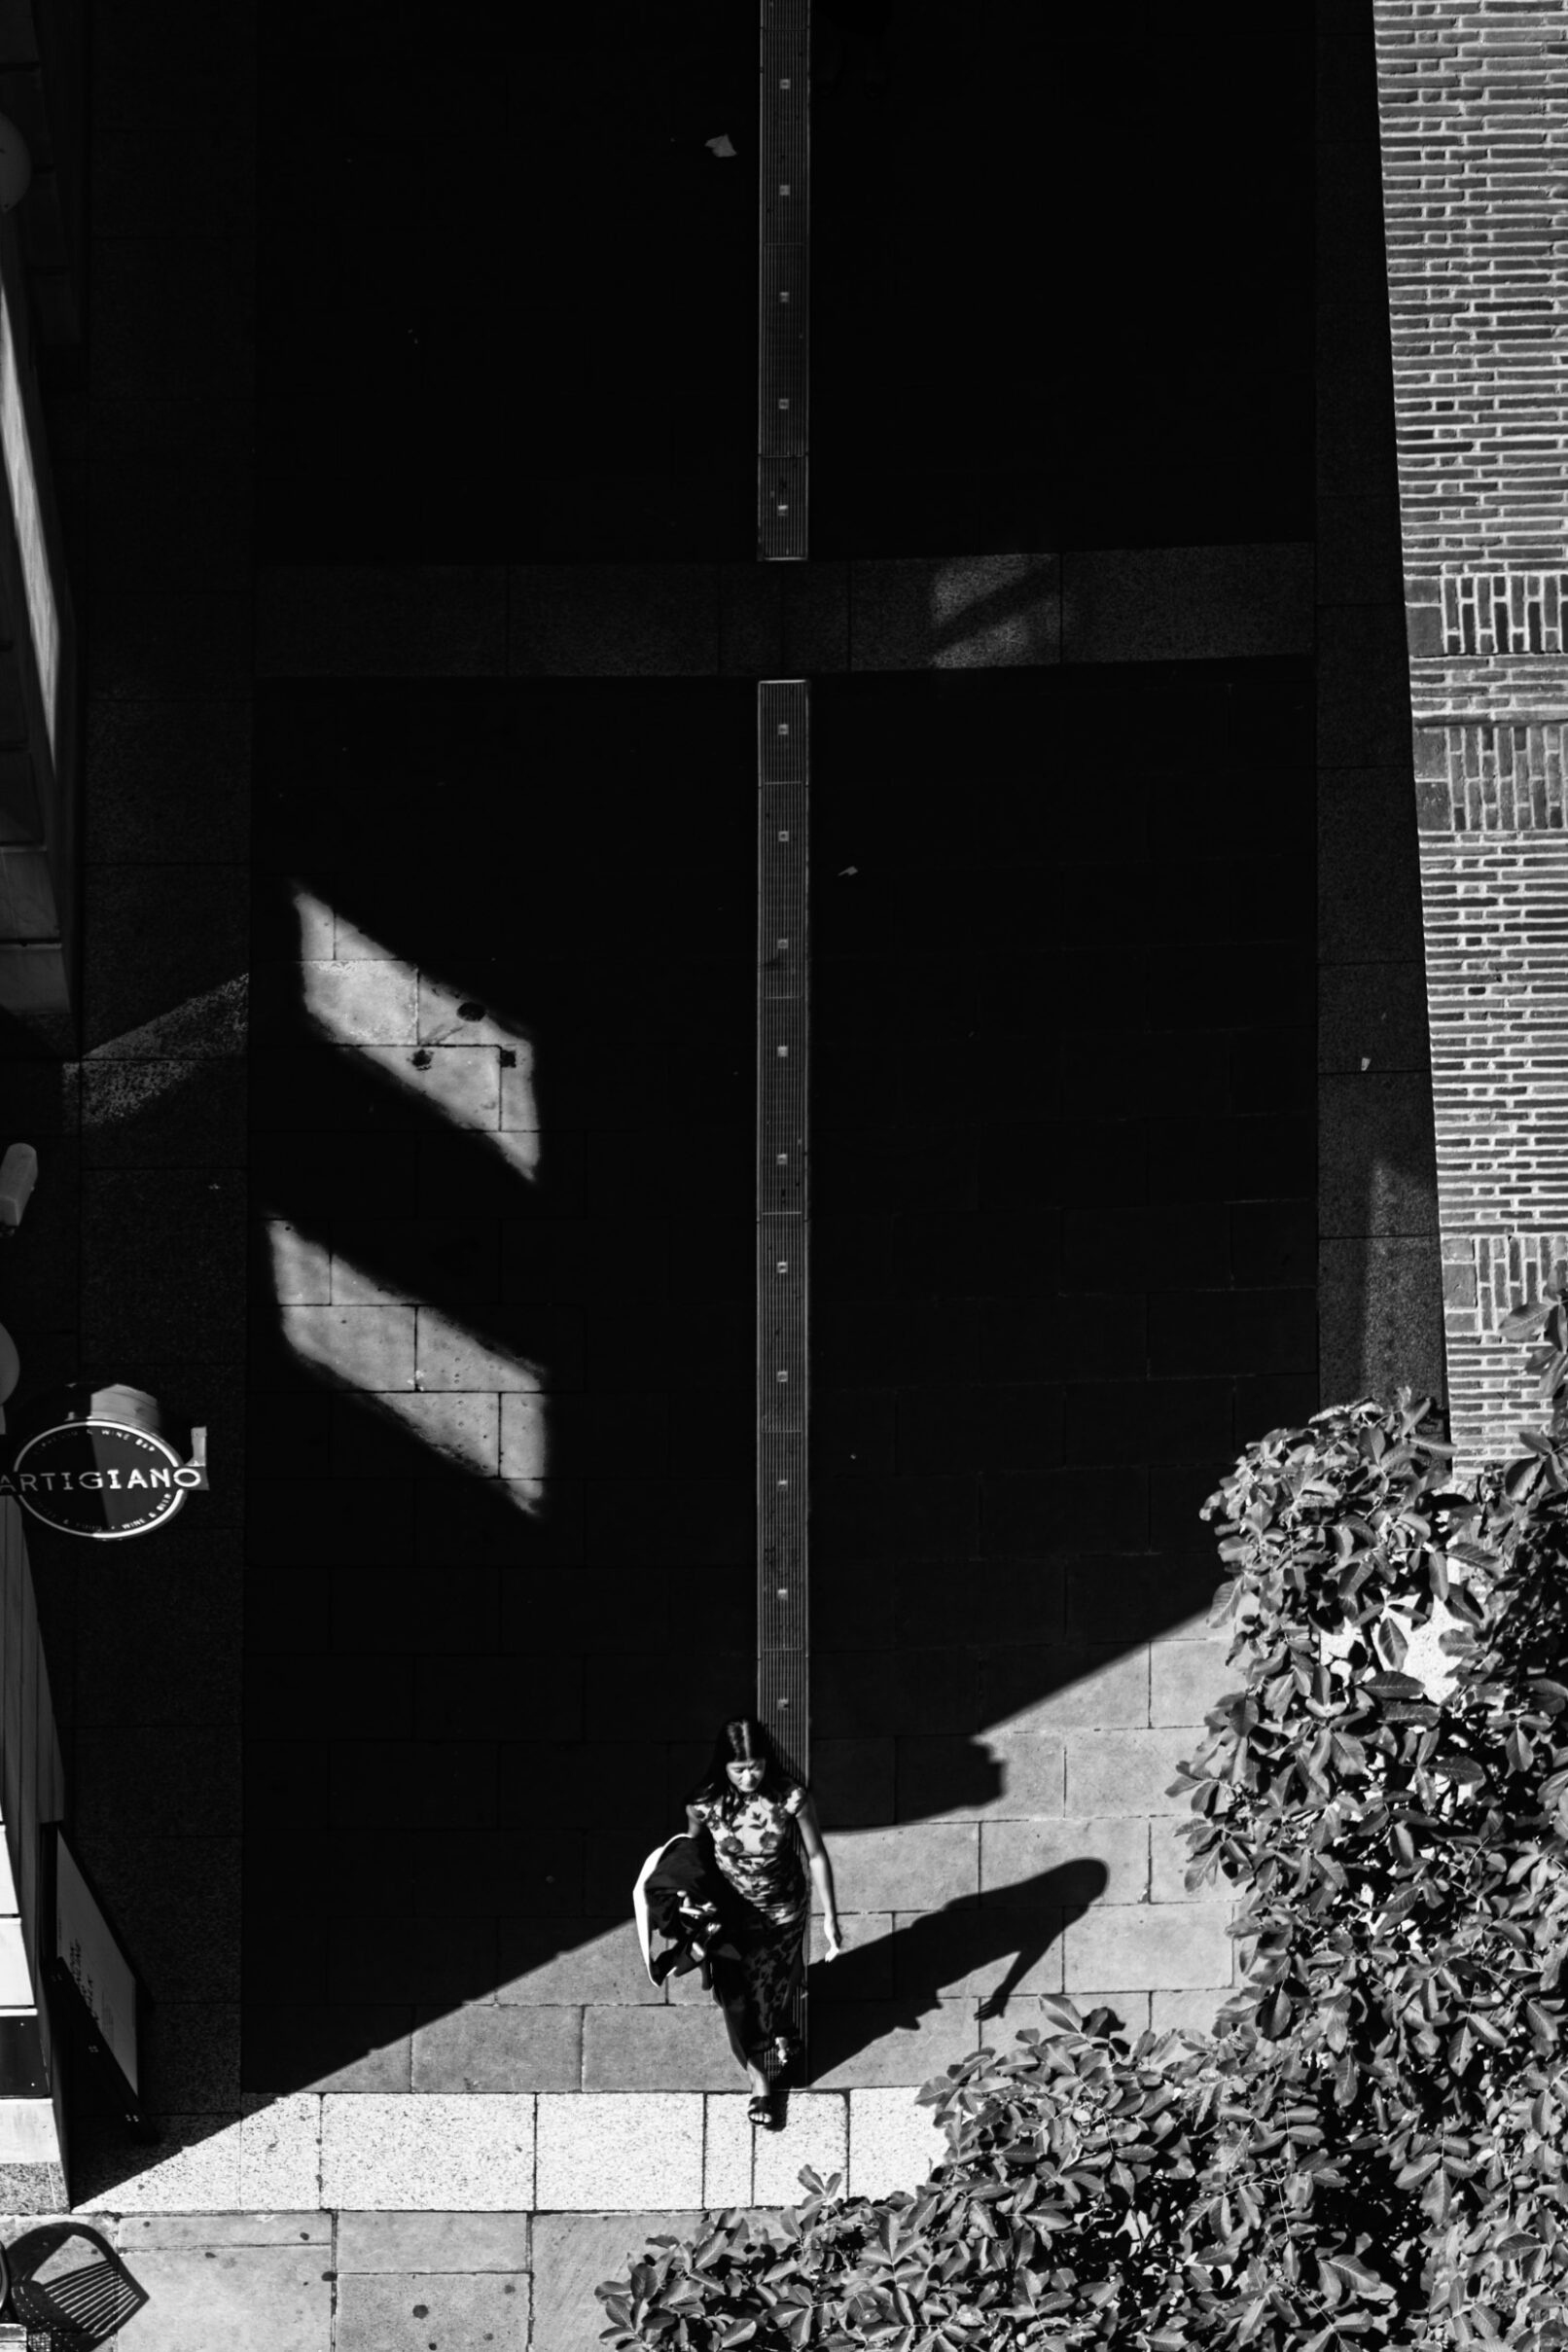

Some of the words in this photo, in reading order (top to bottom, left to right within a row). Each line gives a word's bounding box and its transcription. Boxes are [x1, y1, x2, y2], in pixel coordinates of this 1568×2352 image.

[101, 1429, 130, 1441] WINE
[0, 1468, 201, 1492] ARTIGIANO
[121, 1517, 147, 1530] WINE
[156, 1493, 172, 1512] BEER
